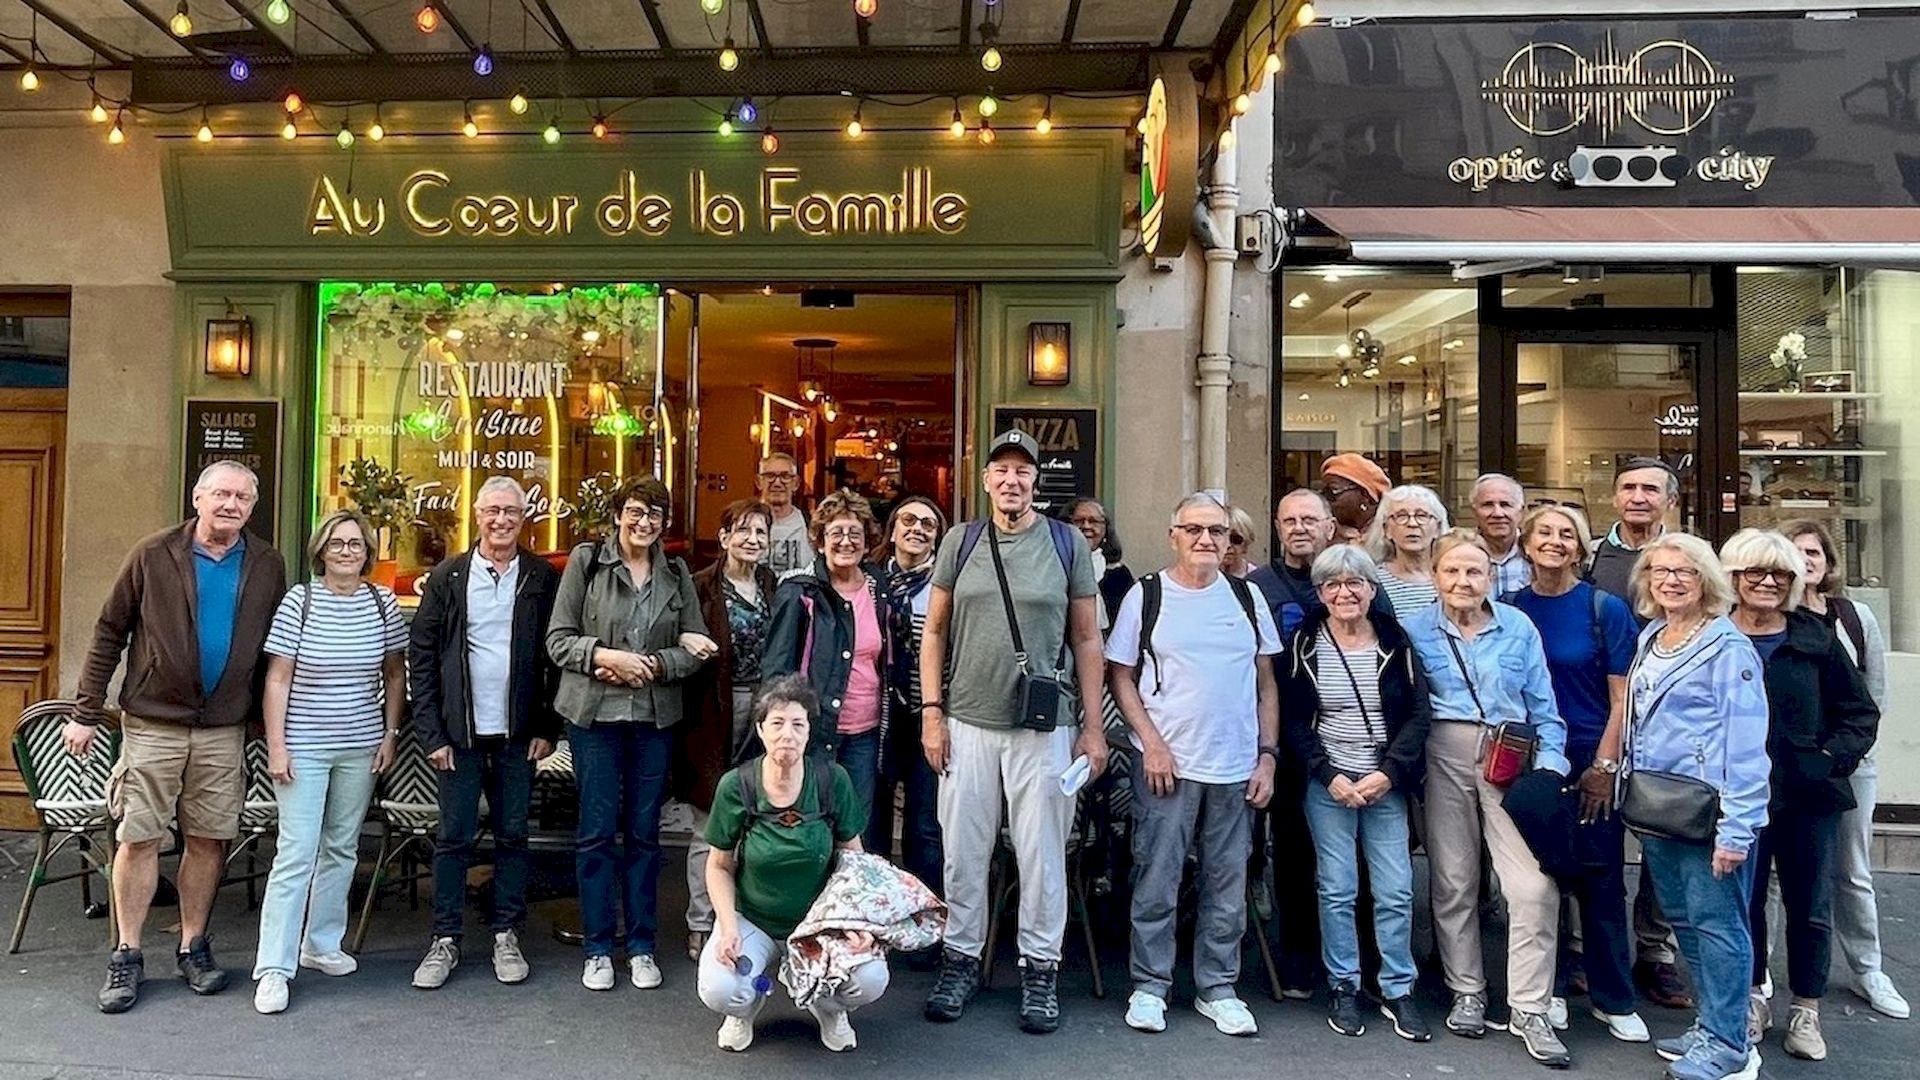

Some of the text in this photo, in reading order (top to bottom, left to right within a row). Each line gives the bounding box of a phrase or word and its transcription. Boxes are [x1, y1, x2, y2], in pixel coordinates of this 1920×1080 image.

[1447, 147, 1546, 191] optic
[1697, 146, 1775, 191] city
[305, 172, 386, 237] Au
[595, 169, 672, 236] de
[690, 165, 745, 236] la
[759, 165, 968, 236] Famille
[418, 361, 567, 399] RESTAURANT
[200, 412, 257, 429] SALADES
[480, 453, 492, 469] &
[495, 450, 536, 469] SOIR
[413, 481, 462, 516] Fait
